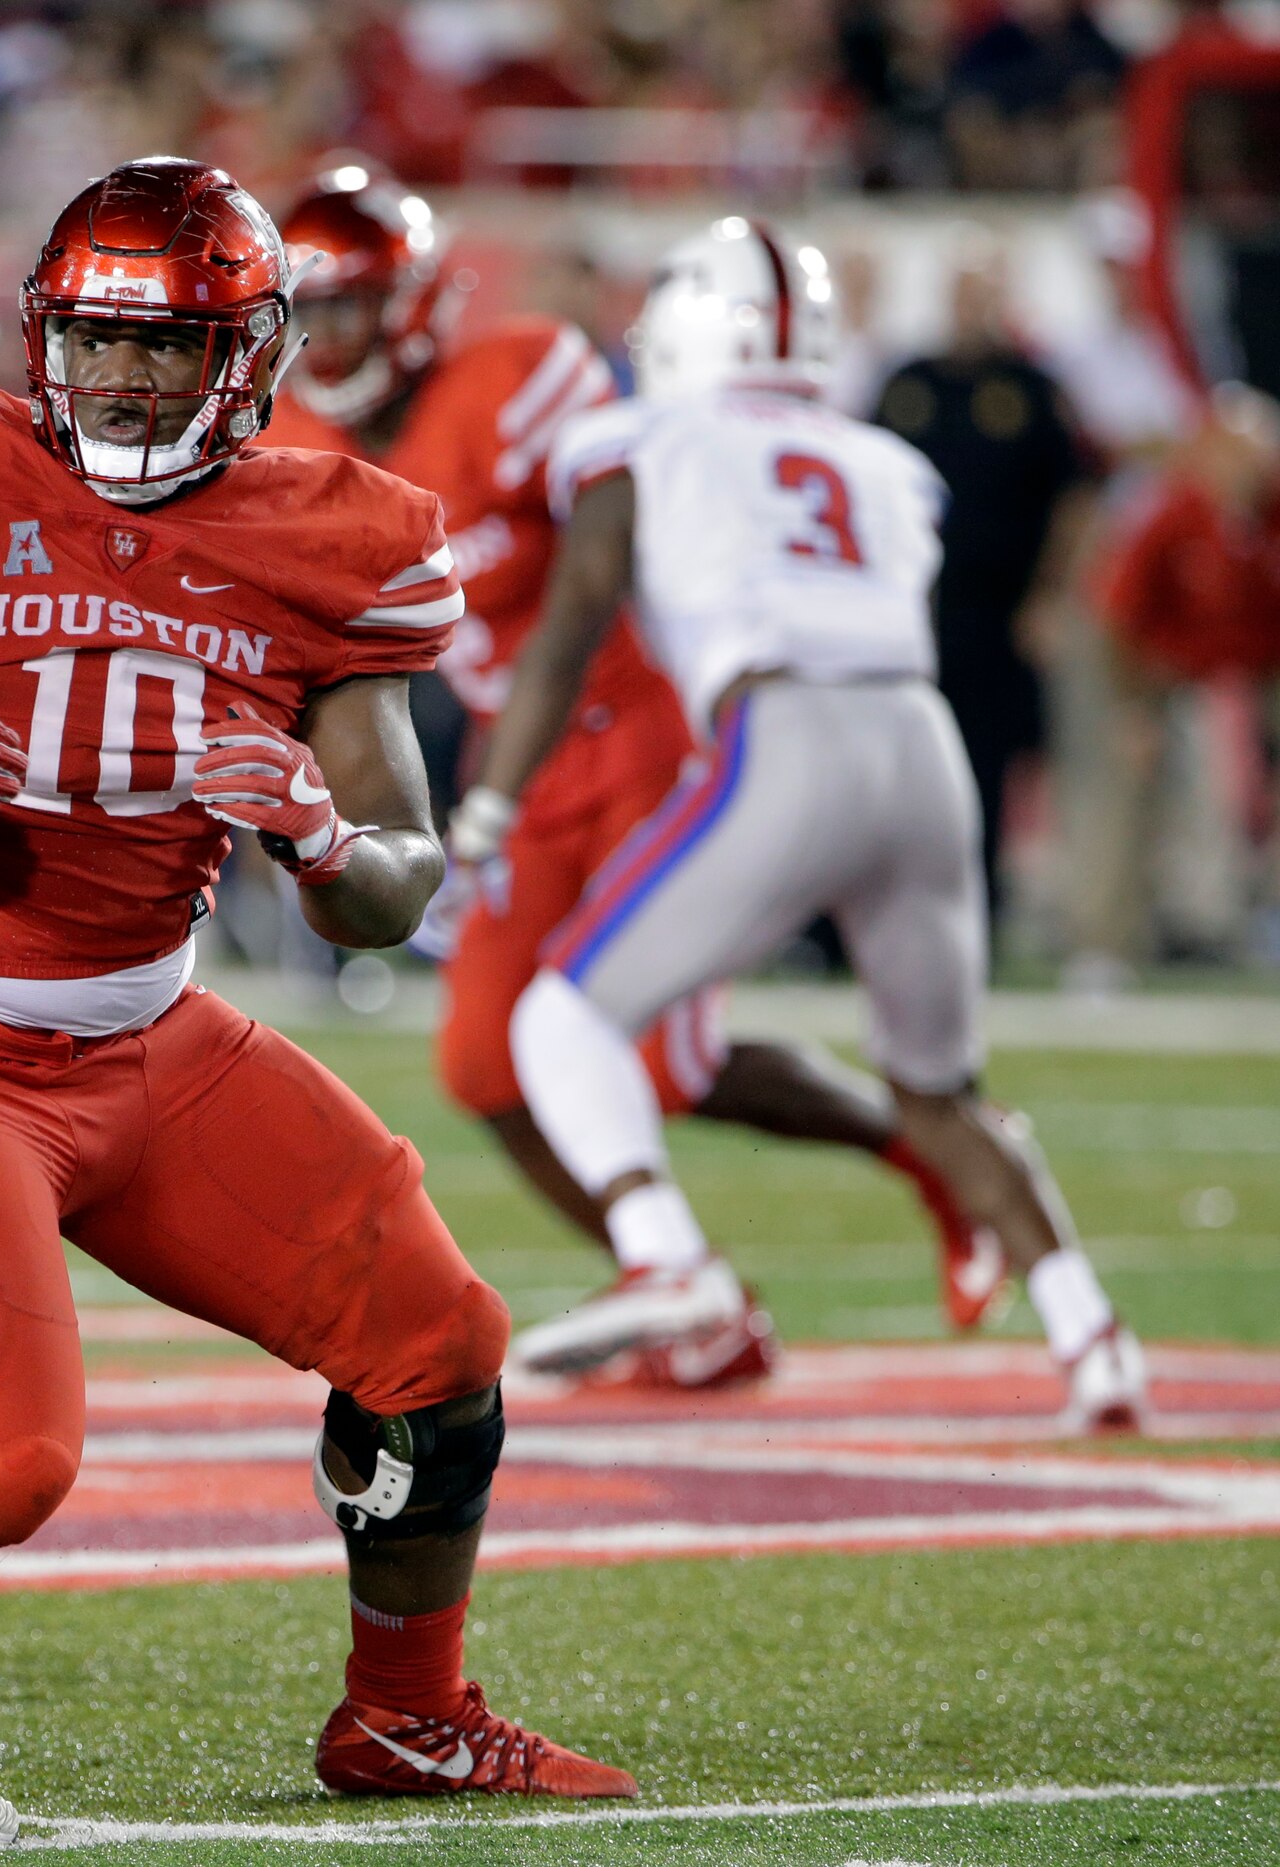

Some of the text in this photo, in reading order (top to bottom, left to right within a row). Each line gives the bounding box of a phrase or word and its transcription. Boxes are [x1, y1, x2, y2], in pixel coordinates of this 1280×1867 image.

[3, 520, 54, 577] A
[773, 451, 864, 571] 3
[8, 646, 207, 818] 10
[194, 897, 206, 916] XL
